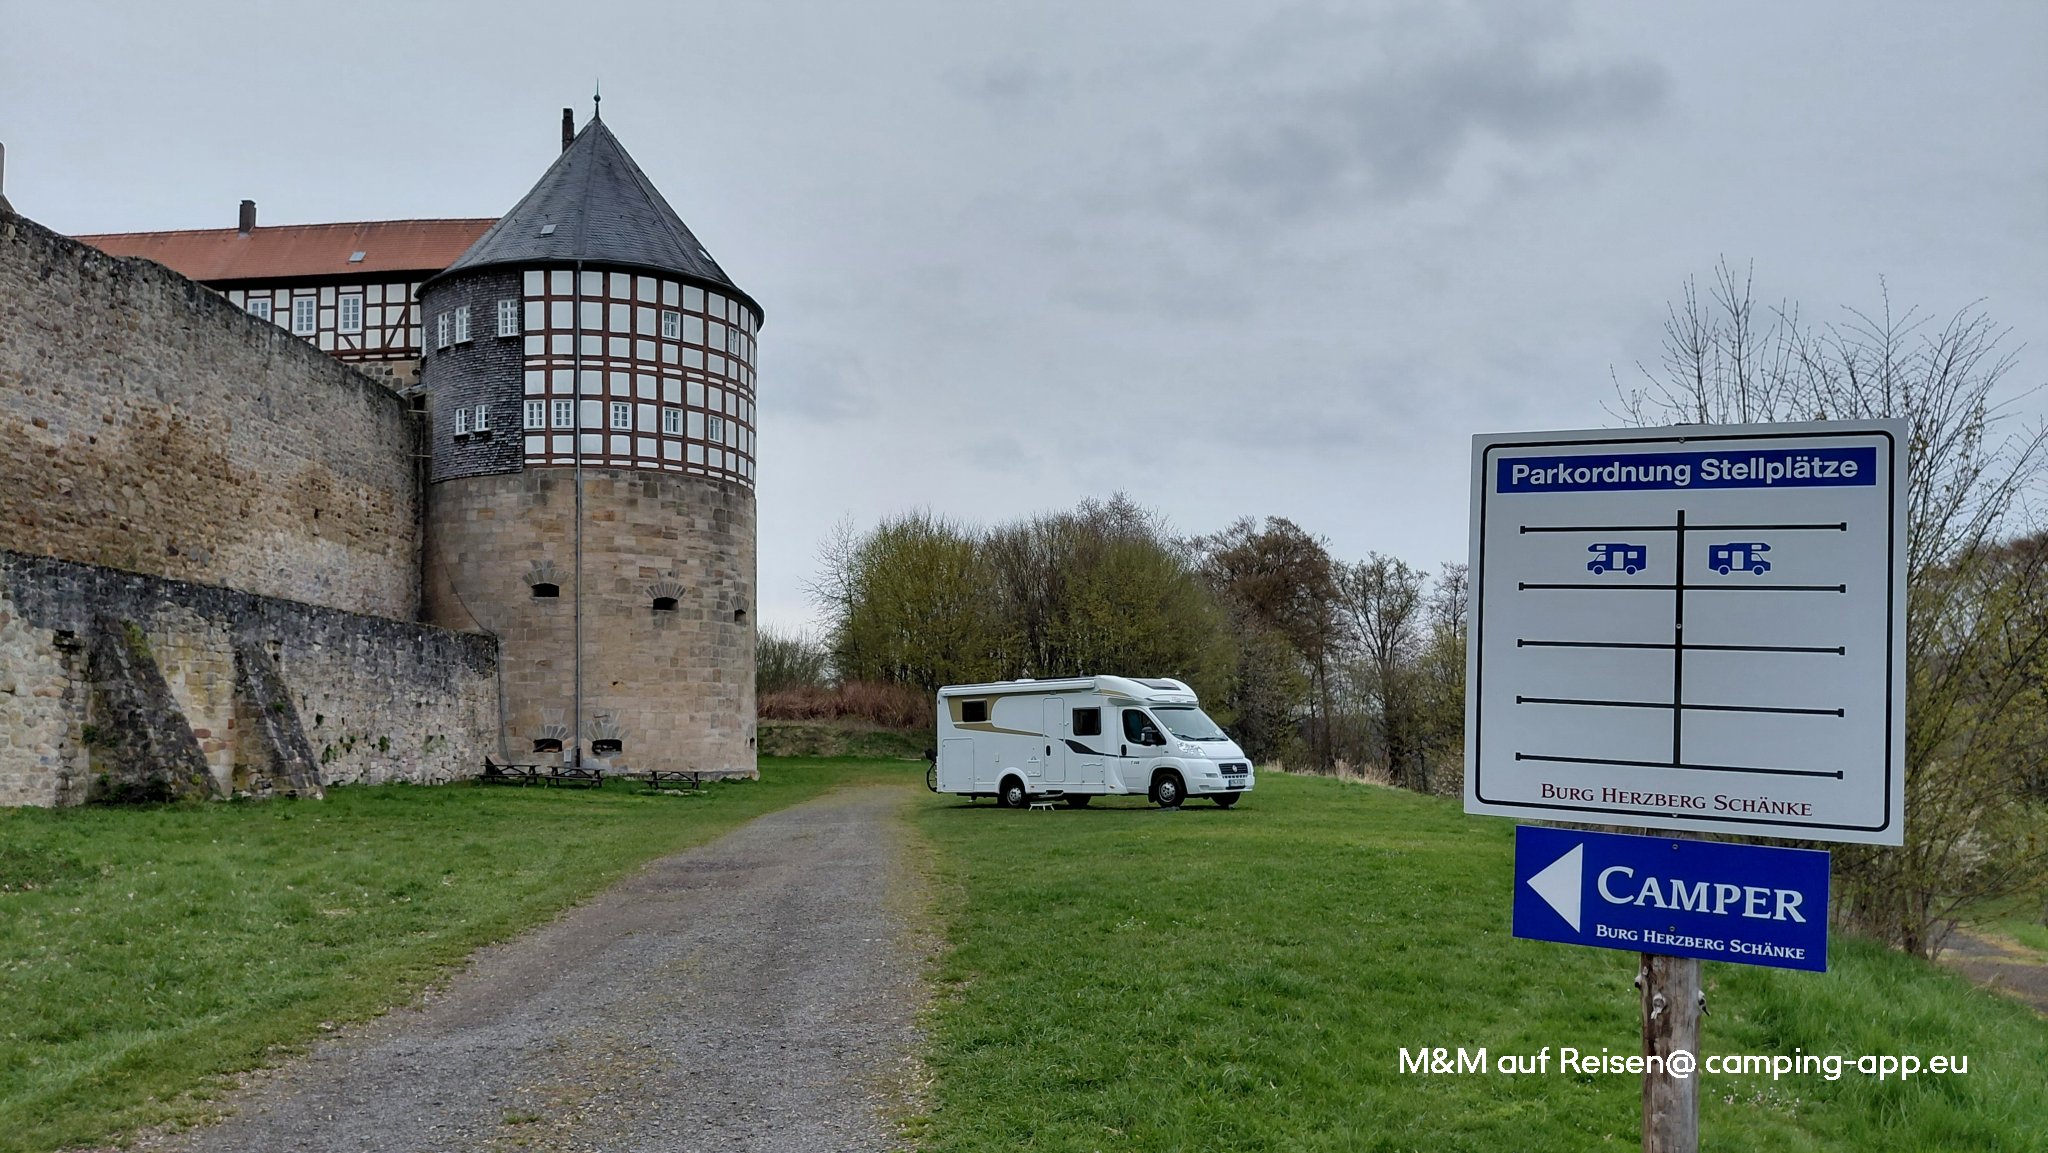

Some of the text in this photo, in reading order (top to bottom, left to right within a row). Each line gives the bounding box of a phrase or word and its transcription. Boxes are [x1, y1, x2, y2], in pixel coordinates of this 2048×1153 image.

[1511, 456, 1859, 486] Parkordnung Stellplätze
[1541, 783, 1814, 817] BURG HERZBERG SCHÄNKE
[1597, 866, 1807, 923] CAMPER
[1596, 924, 1806, 960] BURG HERZBERG SCHÄNKE
